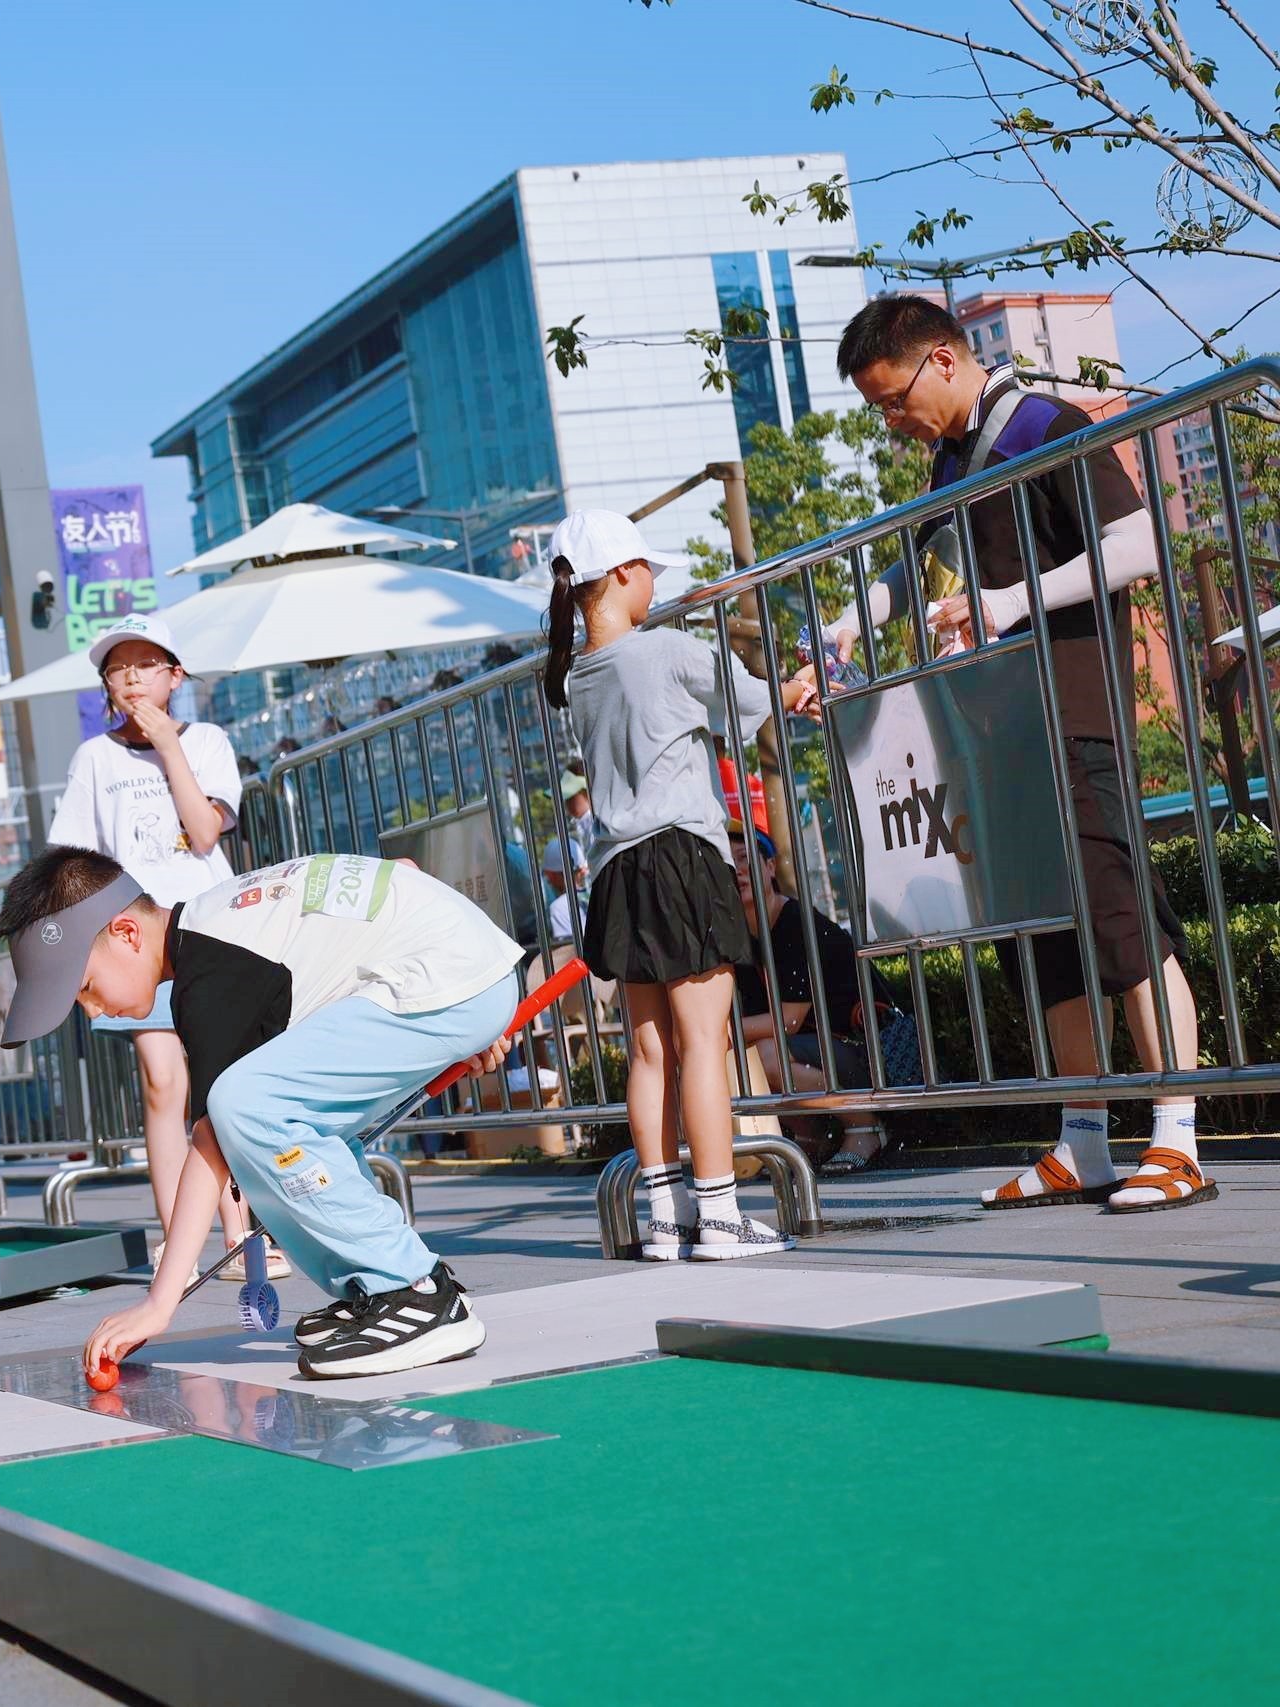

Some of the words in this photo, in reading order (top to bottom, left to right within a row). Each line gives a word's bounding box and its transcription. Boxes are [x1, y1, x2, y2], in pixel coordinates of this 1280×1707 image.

[67, 575, 158, 613] LET'S
[105, 776, 154, 795] WORLD'S
[876, 770, 896, 797] the
